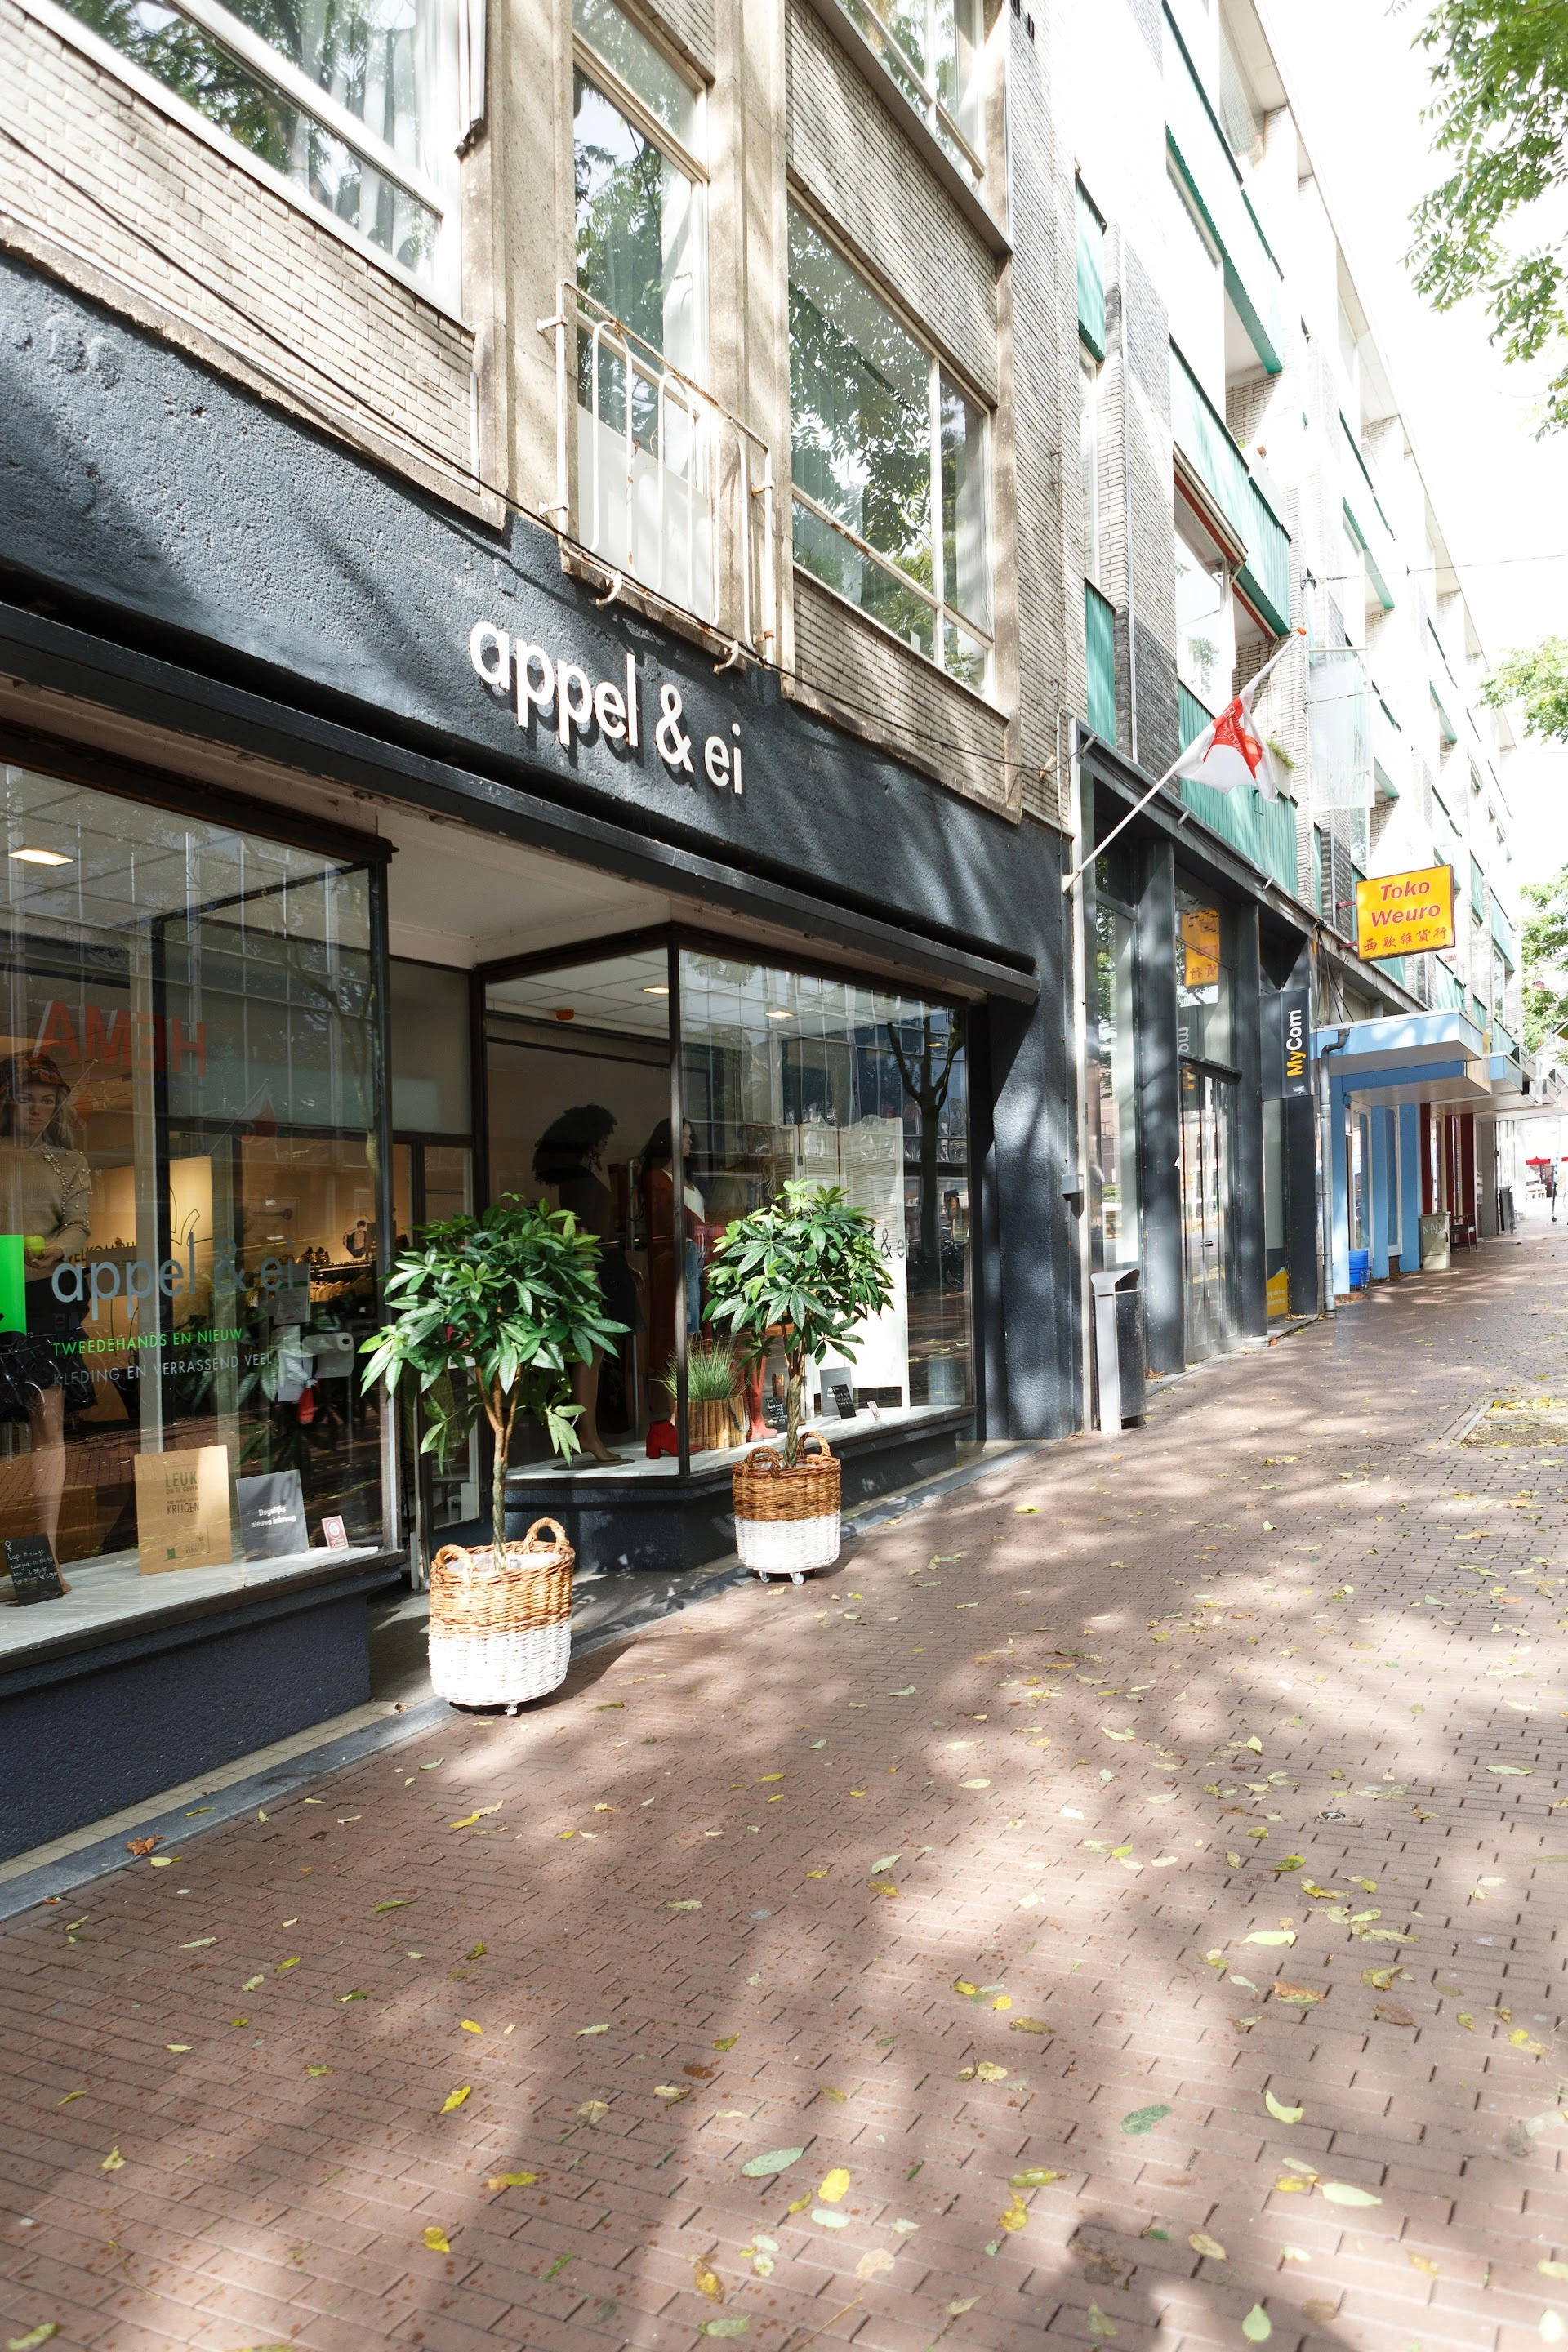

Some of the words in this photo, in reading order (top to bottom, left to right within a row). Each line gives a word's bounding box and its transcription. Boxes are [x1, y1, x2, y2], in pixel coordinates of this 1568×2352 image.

[470, 621, 638, 746] appel
[656, 684, 694, 773] &
[705, 723, 742, 795] ei
[1380, 881, 1430, 901] Toko
[1371, 904, 1441, 928] Weuro
[1286, 1009, 1307, 1076] MyCom
[880, 1228, 893, 1259] &
[51, 1231, 196, 1321] appel
[214, 1237, 247, 1294] &
[261, 1238, 294, 1291] ei
[53, 1334, 167, 1356] TWEEDEHANDS
[172, 1331, 192, 1346] EN
[198, 1327, 243, 1344] NIEUW
[53, 1367, 120, 1387] KLEDING
[127, 1364, 147, 1380] EN
[154, 1355, 239, 1377] VERRASSEND
[244, 1352, 273, 1367] VEEL
[166, 1471, 198, 1487] LEUK
[183, 1485, 199, 1493] GEVEN
[167, 1502, 200, 1515] KRIJGEN
[258, 1505, 287, 1517] Dagelijks
[251, 1520, 273, 1528] nieuwe
